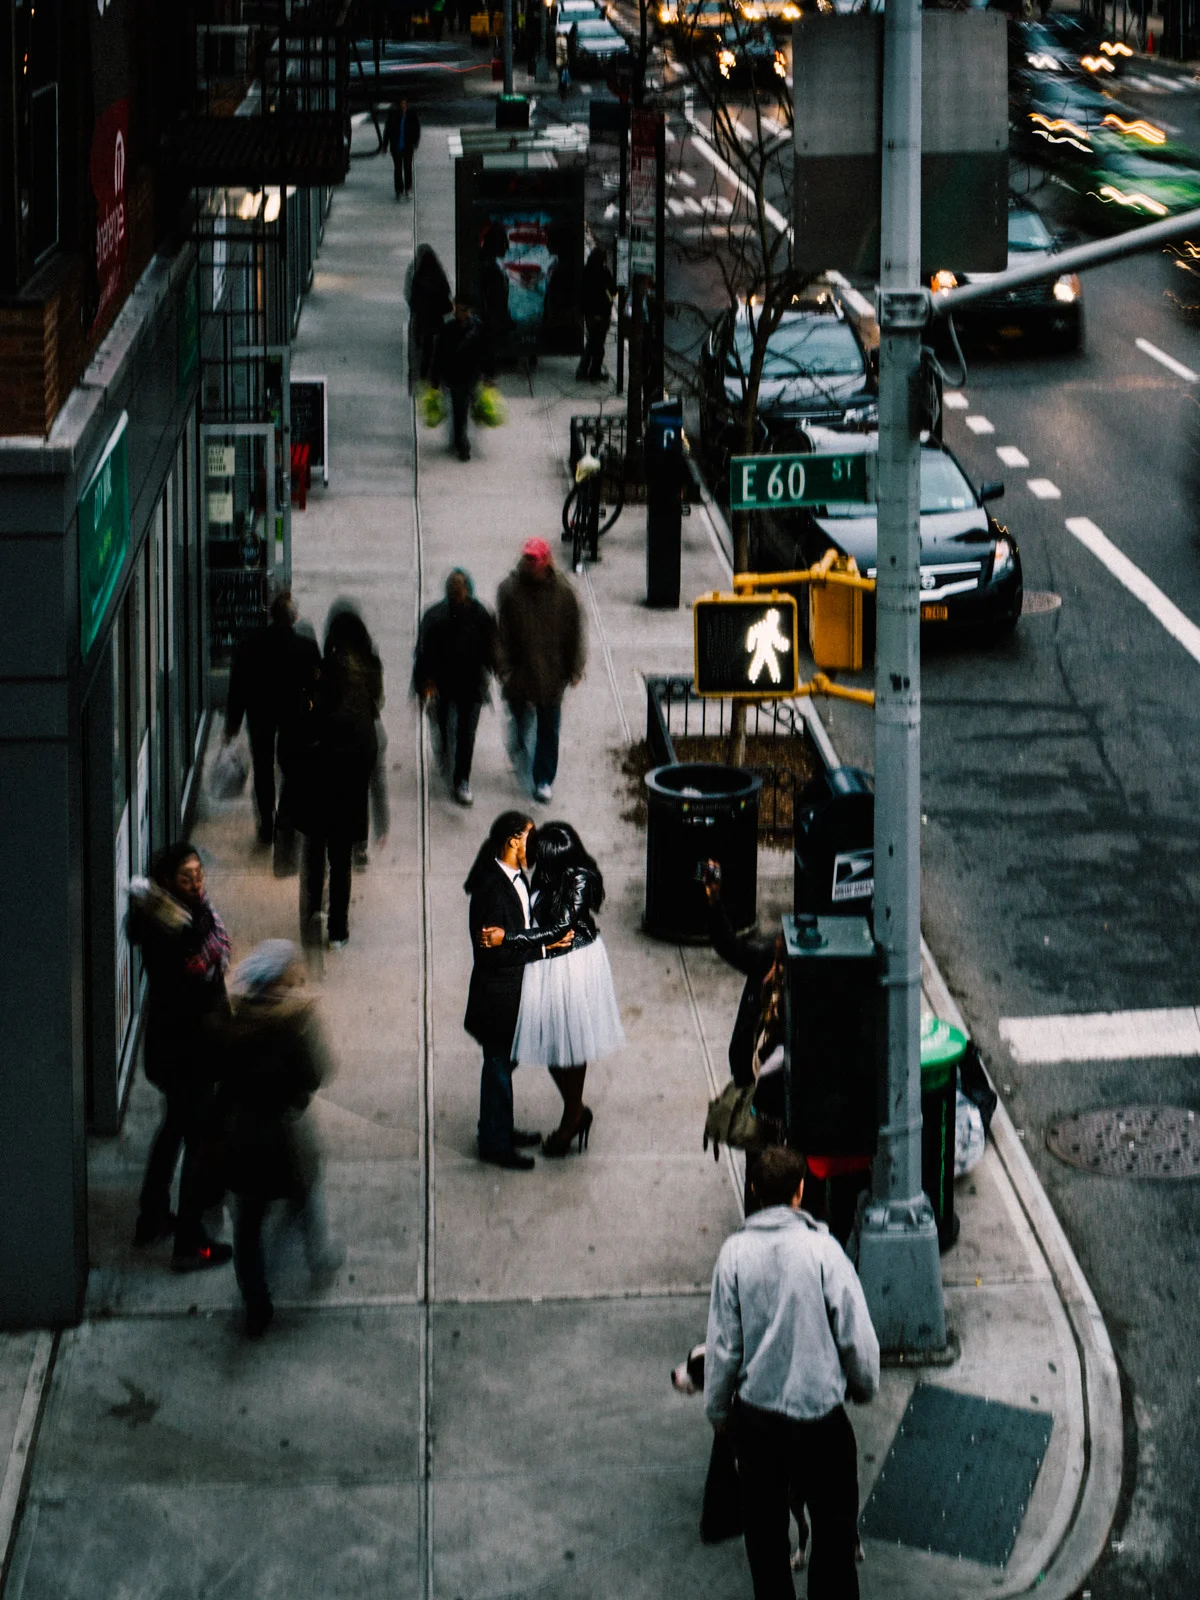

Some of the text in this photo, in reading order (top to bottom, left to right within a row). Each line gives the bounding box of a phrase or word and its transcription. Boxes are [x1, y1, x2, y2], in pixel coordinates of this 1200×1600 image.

[742, 459, 855, 502] E 60 ST
